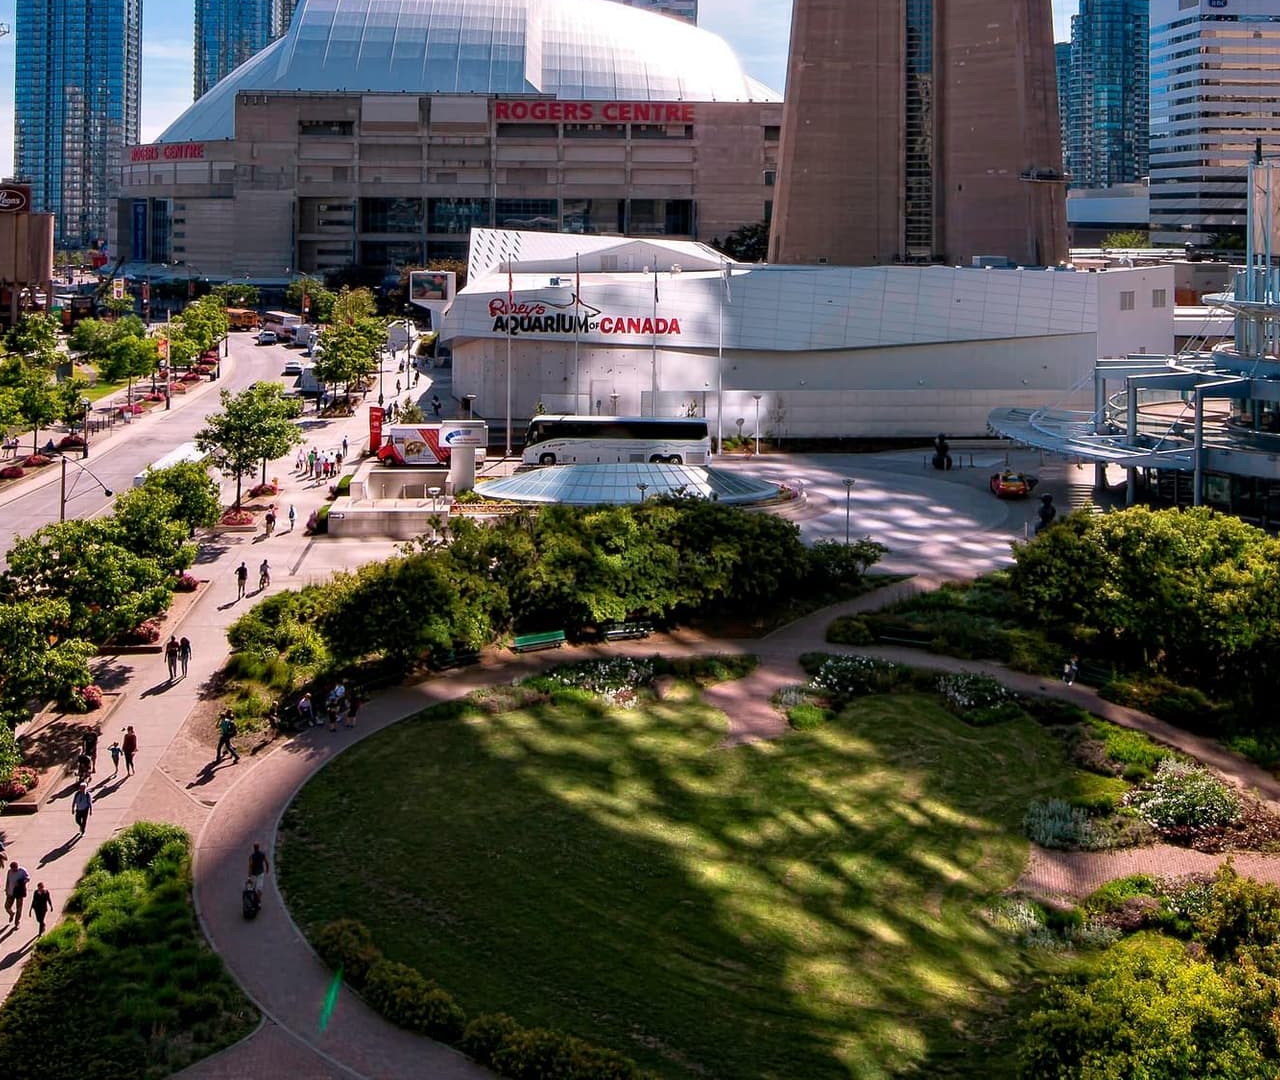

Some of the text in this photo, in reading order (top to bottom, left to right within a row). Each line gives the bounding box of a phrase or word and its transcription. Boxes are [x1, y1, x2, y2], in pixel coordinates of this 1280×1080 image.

[495, 102, 697, 122] ROGERS CENTRE
[493, 312, 681, 335] AQUARIUM OF CANADA
